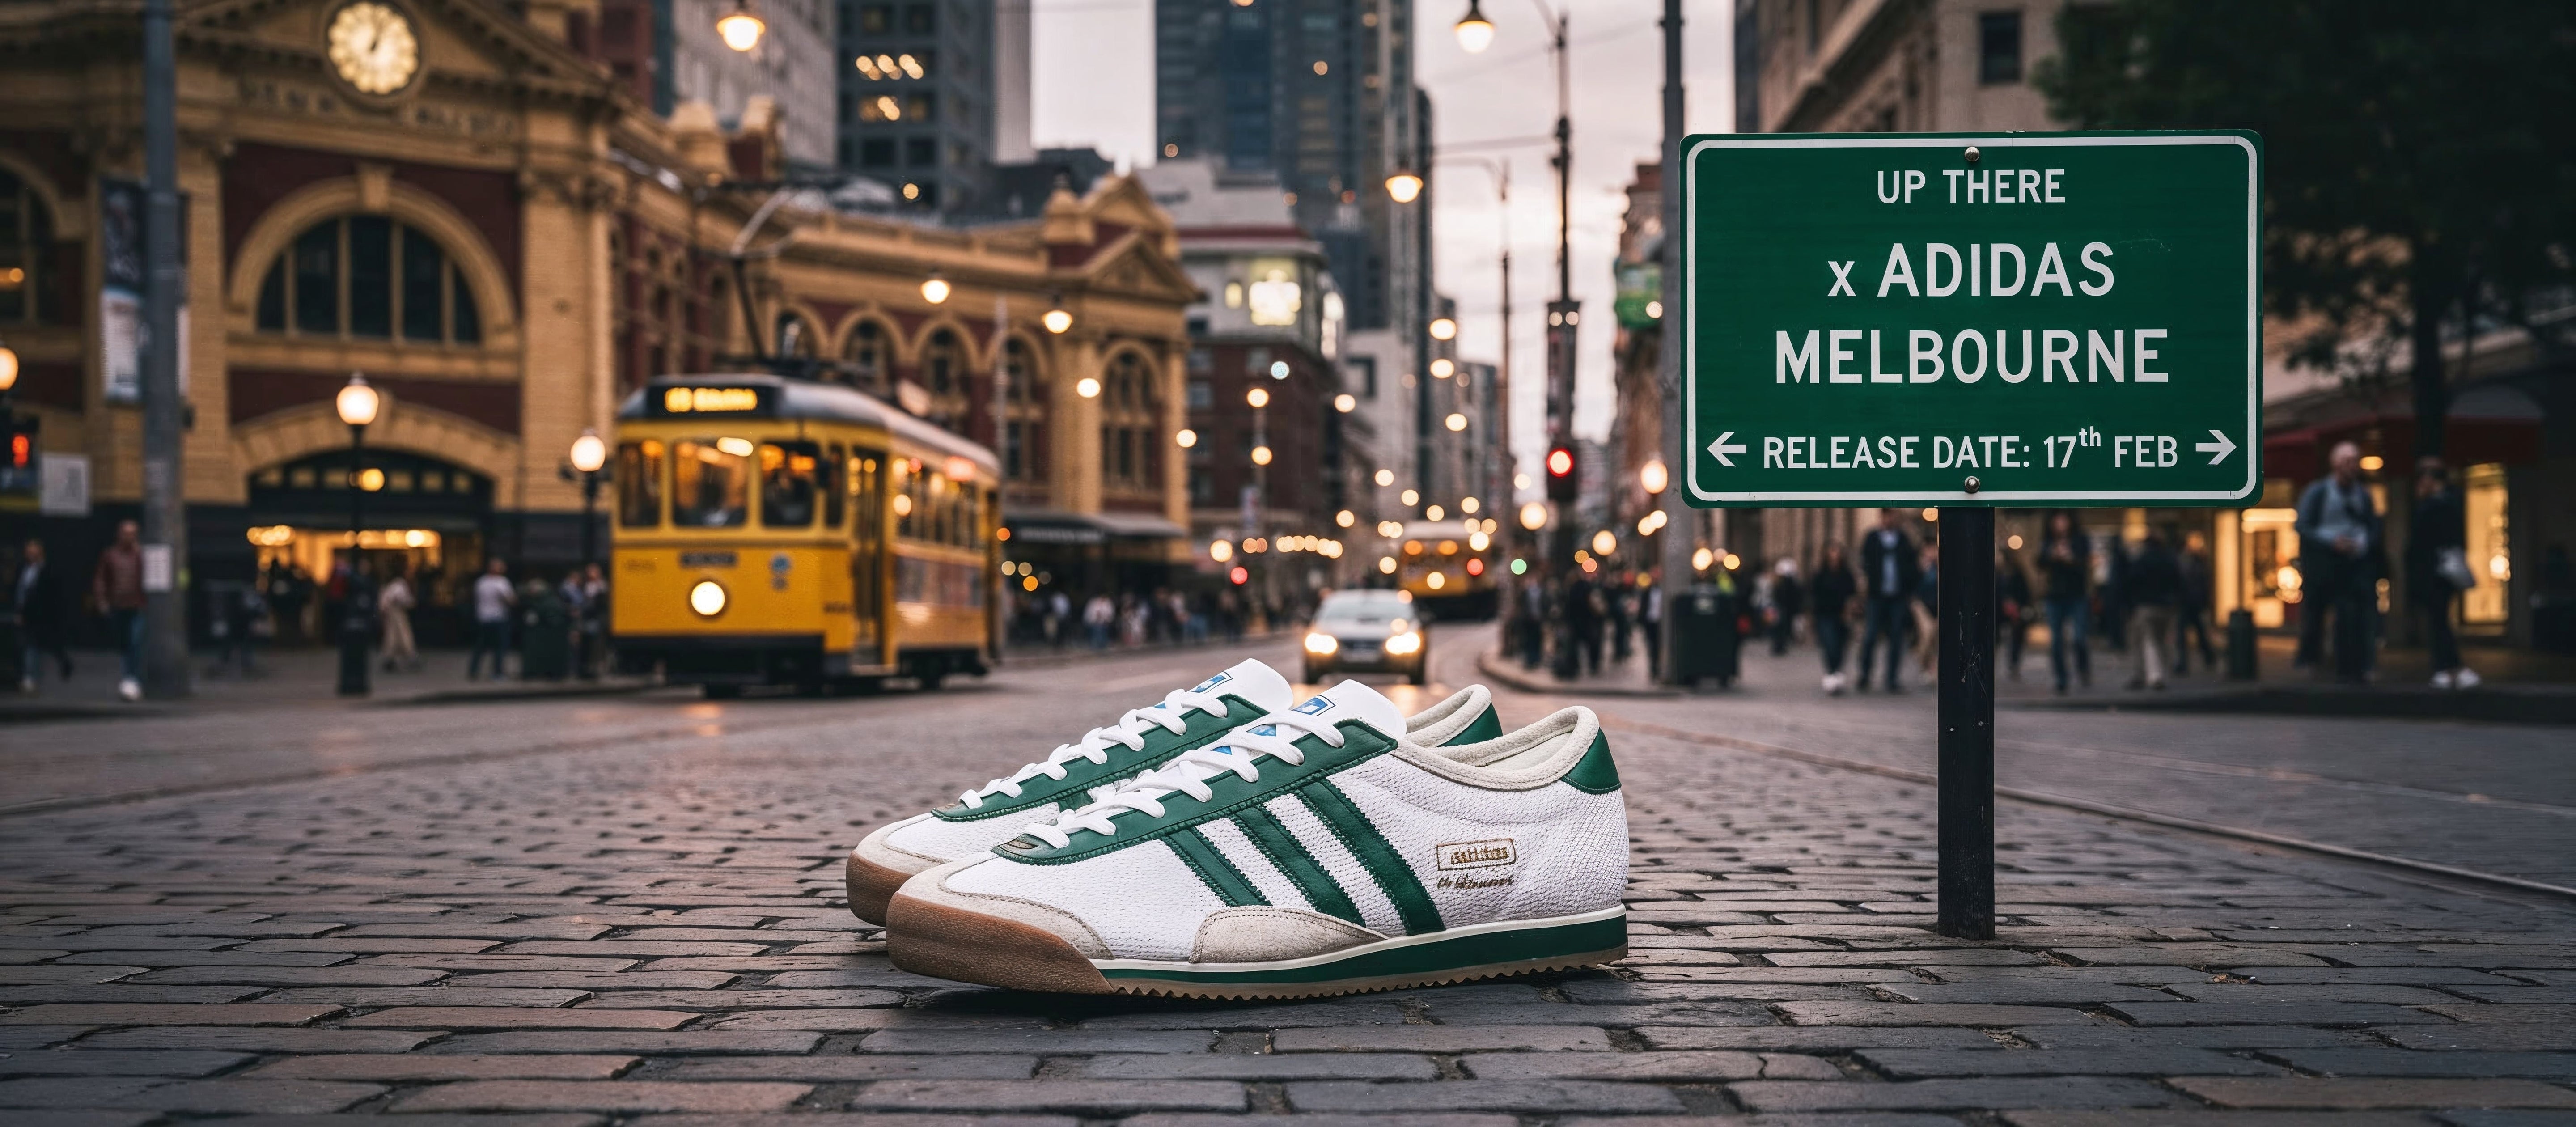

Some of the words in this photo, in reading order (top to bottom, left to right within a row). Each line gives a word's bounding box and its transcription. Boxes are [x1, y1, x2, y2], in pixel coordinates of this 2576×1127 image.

[1878, 170, 1926, 204] UP
[1942, 169, 2065, 203] THERE
[1827, 261, 1856, 297] x
[1877, 242, 2114, 297] ADIDAS
[1776, 329, 2169, 384] MELBOURNE
[1764, 436, 1919, 469] RELEASE
[1933, 436, 2030, 468] DATE:
[2043, 425, 2101, 468] 17th
[2114, 436, 2178, 468] FEB
